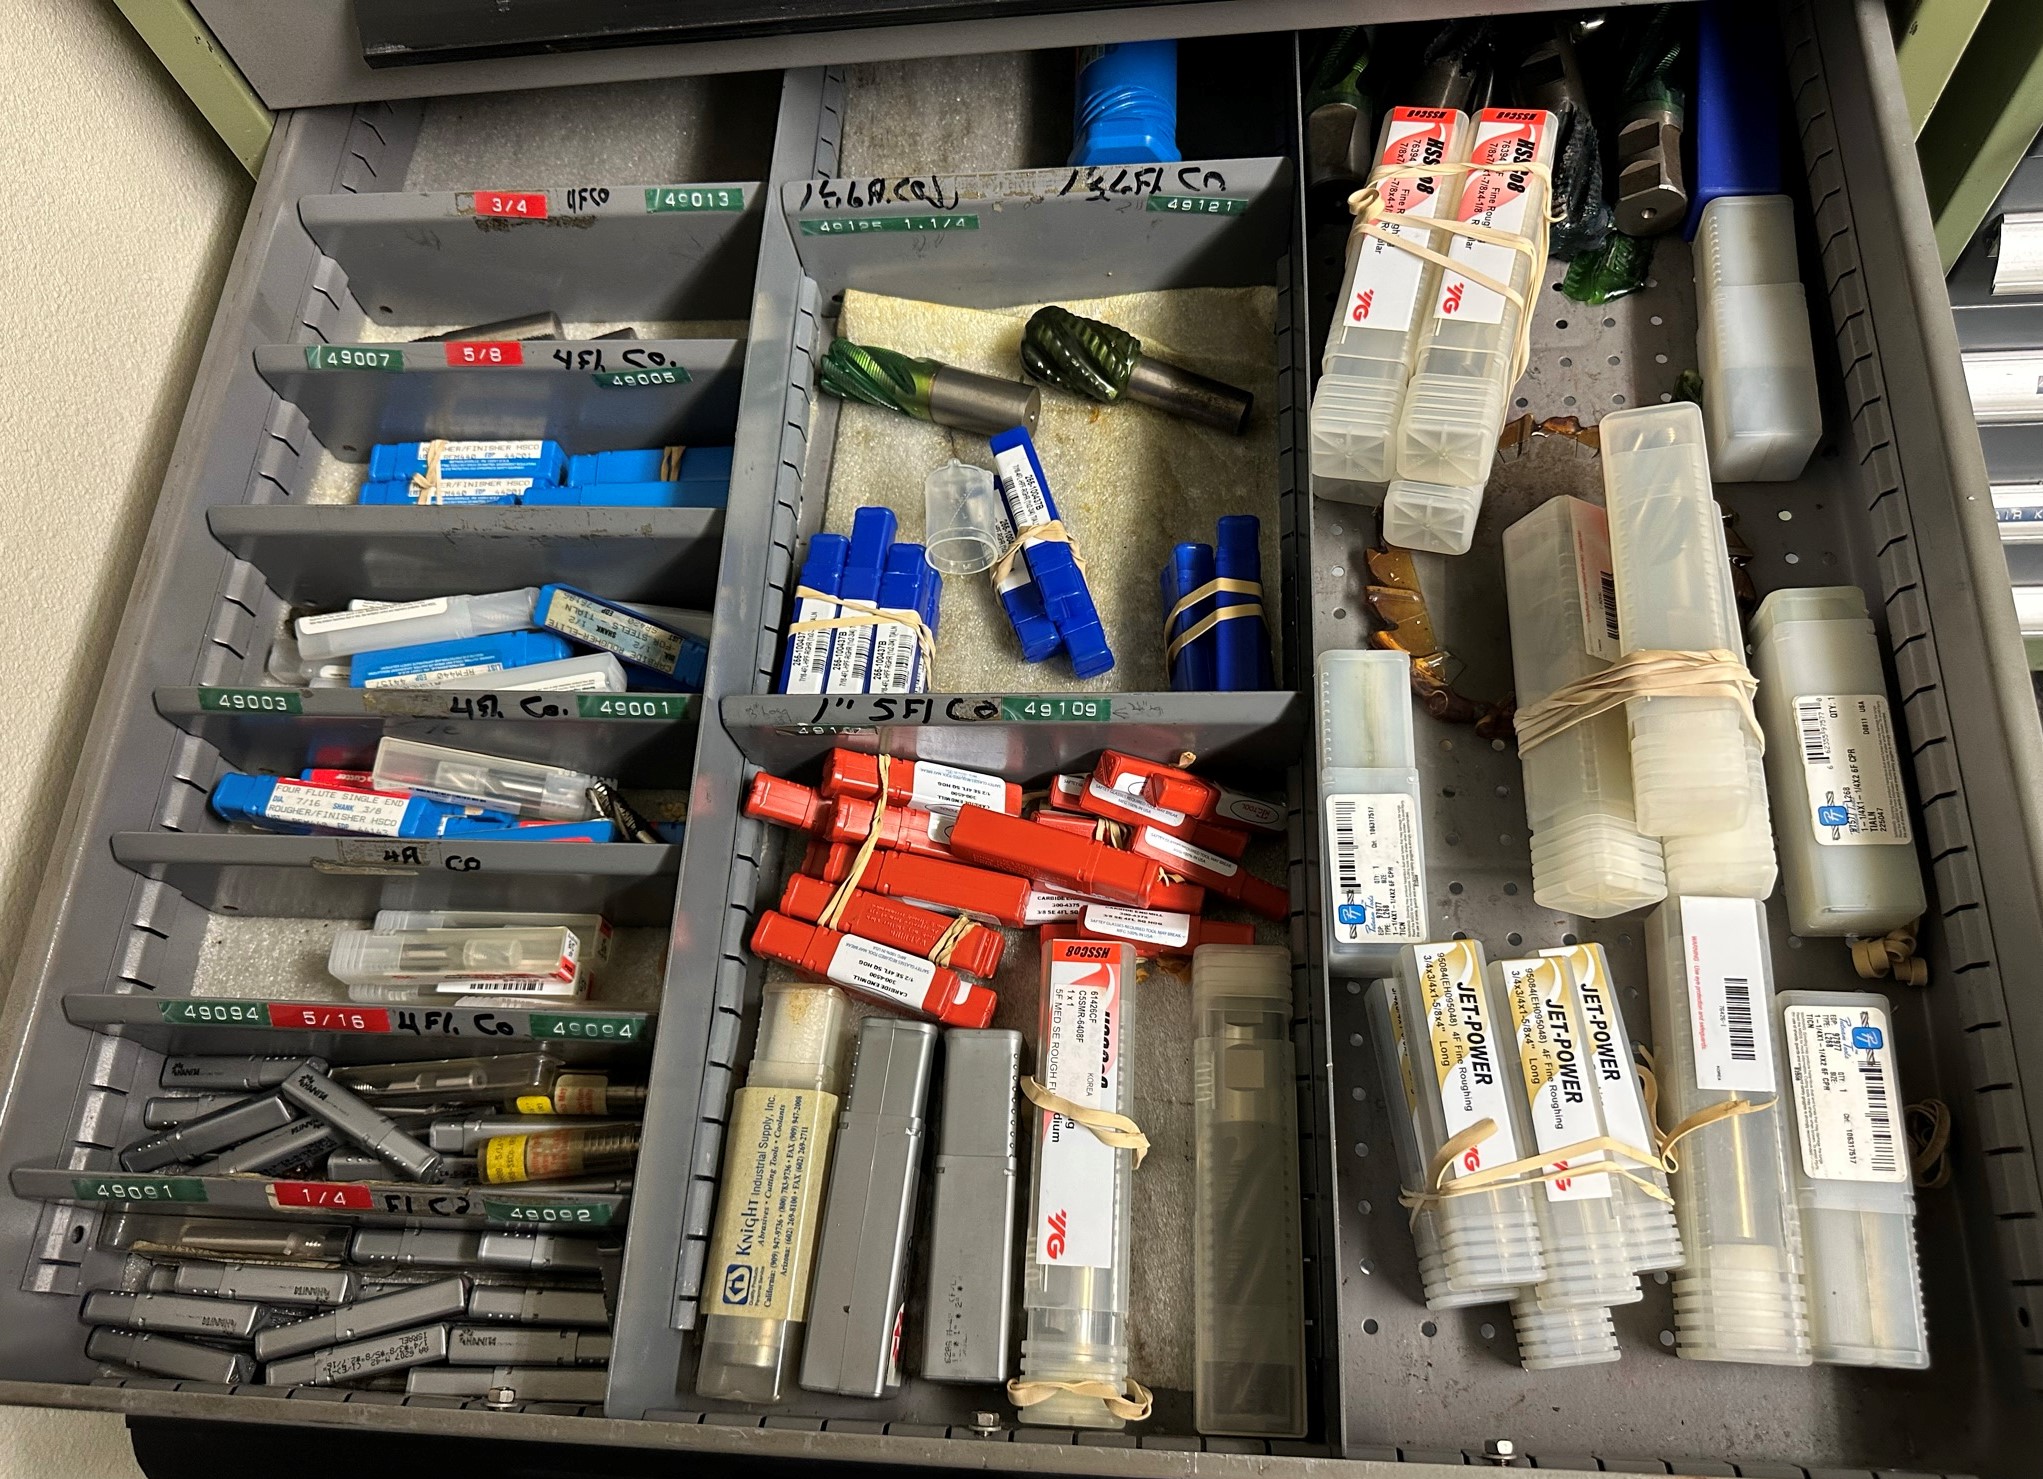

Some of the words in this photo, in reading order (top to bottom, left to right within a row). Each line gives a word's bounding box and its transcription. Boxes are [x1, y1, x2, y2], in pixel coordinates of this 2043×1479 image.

[1415, 137, 1444, 195] HSSo8
[664, 192, 730, 208] 49013
[1397, 188, 1410, 209] Fine
[1488, 186, 1500, 204] Fine
[492, 197, 528, 214] 3/4
[1167, 198, 1233, 212] 49121
[904, 217, 966, 230] 1.1/4
[326, 350, 390, 368] 49007
[462, 346, 503, 363] 5/8
[611, 370, 677, 388] 49005
[506, 479, 530, 487] HSCO
[564, 603, 596, 621] TIALN
[601, 606, 614, 617] EDP
[567, 614, 588, 628] 1/2
[545, 616, 625, 655] ROUGHER-ELITE
[594, 624, 617, 639] SHANK
[611, 621, 649, 642] STEELS
[668, 633, 683, 644] LIST
[631, 640, 651, 654] 1/2
[653, 637, 672, 651] FOR
[486, 663, 501, 672] LIST
[629, 650, 673, 673] CARBIDE
[415, 673, 427, 681] EDP
[218, 693, 288, 711] 49003
[599, 701, 670, 716] 49001
[1023, 700, 1098, 717] 49109
[1827, 702, 1838, 719] QTY:
[1857, 700, 1865, 712] USA
[1846, 747, 1856, 762] CPR
[1849, 763, 1858, 773] 6F
[276, 783, 300, 794] FOUR
[304, 786, 336, 799] FLUTE
[342, 791, 379, 804] SINGLE
[384, 797, 404, 807] END
[272, 794, 284, 803] DIA
[296, 796, 321, 807] 7/16
[331, 801, 354, 812] SHANK
[361, 805, 381, 815] 3/8
[269, 801, 366, 825] ROUGHER/FINISHER
[371, 816, 397, 827] HSCO
[1867, 810, 1878, 833] TIALN
[1876, 806, 1887, 832] 225047
[1398, 921, 1406, 936] TICN
[857, 958, 873, 969] HOG
[872, 963, 882, 972] SQ
[882, 967, 895, 976] 4FL
[851, 974, 881, 988] ENDMILL
[895, 971, 904, 979] SE
[904, 974, 914, 982] 1/2
[879, 983, 908, 998] CARBIDE
[1054, 988, 1063, 999] 5F
[1434, 951, 1458, 1027] 95084(EH095048)
[184, 1003, 260, 1022] 49094
[1052, 1002, 1061, 1024] MED
[1088, 990, 1098, 1023] 61426CF
[1421, 954, 1446, 1033] 3/4x3/4x1-5/8x4"
[1436, 1039, 1452, 1067] Long
[1523, 967, 1548, 1045] 95084(EH095048)
[301, 1011, 366, 1030] 5/16
[1075, 989, 1086, 1043] C5SMR-6408F
[1717, 1004, 1726, 1027] 76426-1
[1805, 1013, 1814, 1028] TICN
[552, 1021, 633, 1039] 49094
[1051, 1026, 1060, 1039] SE
[1451, 1030, 1461, 1042] 4F
[1455, 979, 1493, 1087] JET-POWER
[1510, 969, 1536, 1051] 3/4x3/4x1-5/8x4"
[1526, 1057, 1541, 1086] Long
[1580, 983, 1621, 1082] JET-POWER
[1544, 995, 1583, 1106] JET-POWER
[1830, 1032, 1841, 1052] 97977
[1049, 1041, 1059, 1079] ROUGH
[1453, 1044, 1465, 1064] Fine
[1540, 1047, 1552, 1060] 4F
[1543, 1061, 1556, 1082] Fine
[1820, 1066, 1828, 1075] 6F
[1085, 1072, 1093, 1097] KOREA
[1456, 1066, 1475, 1112] Roughing
[766, 1092, 776, 1111] Inc.
[1546, 1083, 1566, 1130] Roughing
[759, 1112, 774, 1147] Supply,
[773, 1103, 786, 1138] Coolants
[768, 1144, 780, 1165] Tools
[752, 1150, 767, 1196] Industrial
[96, 1183, 174, 1200] 49091
[764, 1168, 777, 1198] Cutting
[301, 1187, 348, 1205] 1/4
[509, 1207, 592, 1222] 49092
[779, 1244, 791, 1275] Arizona:
[791, 1172, 802, 1189] FAX
[757, 1206, 770, 1245] Abrasives
[763, 1269, 777, 1308] California:
[784, 1140, 795, 1157] FAX
[398, 1331, 428, 1344] ISRAEL
